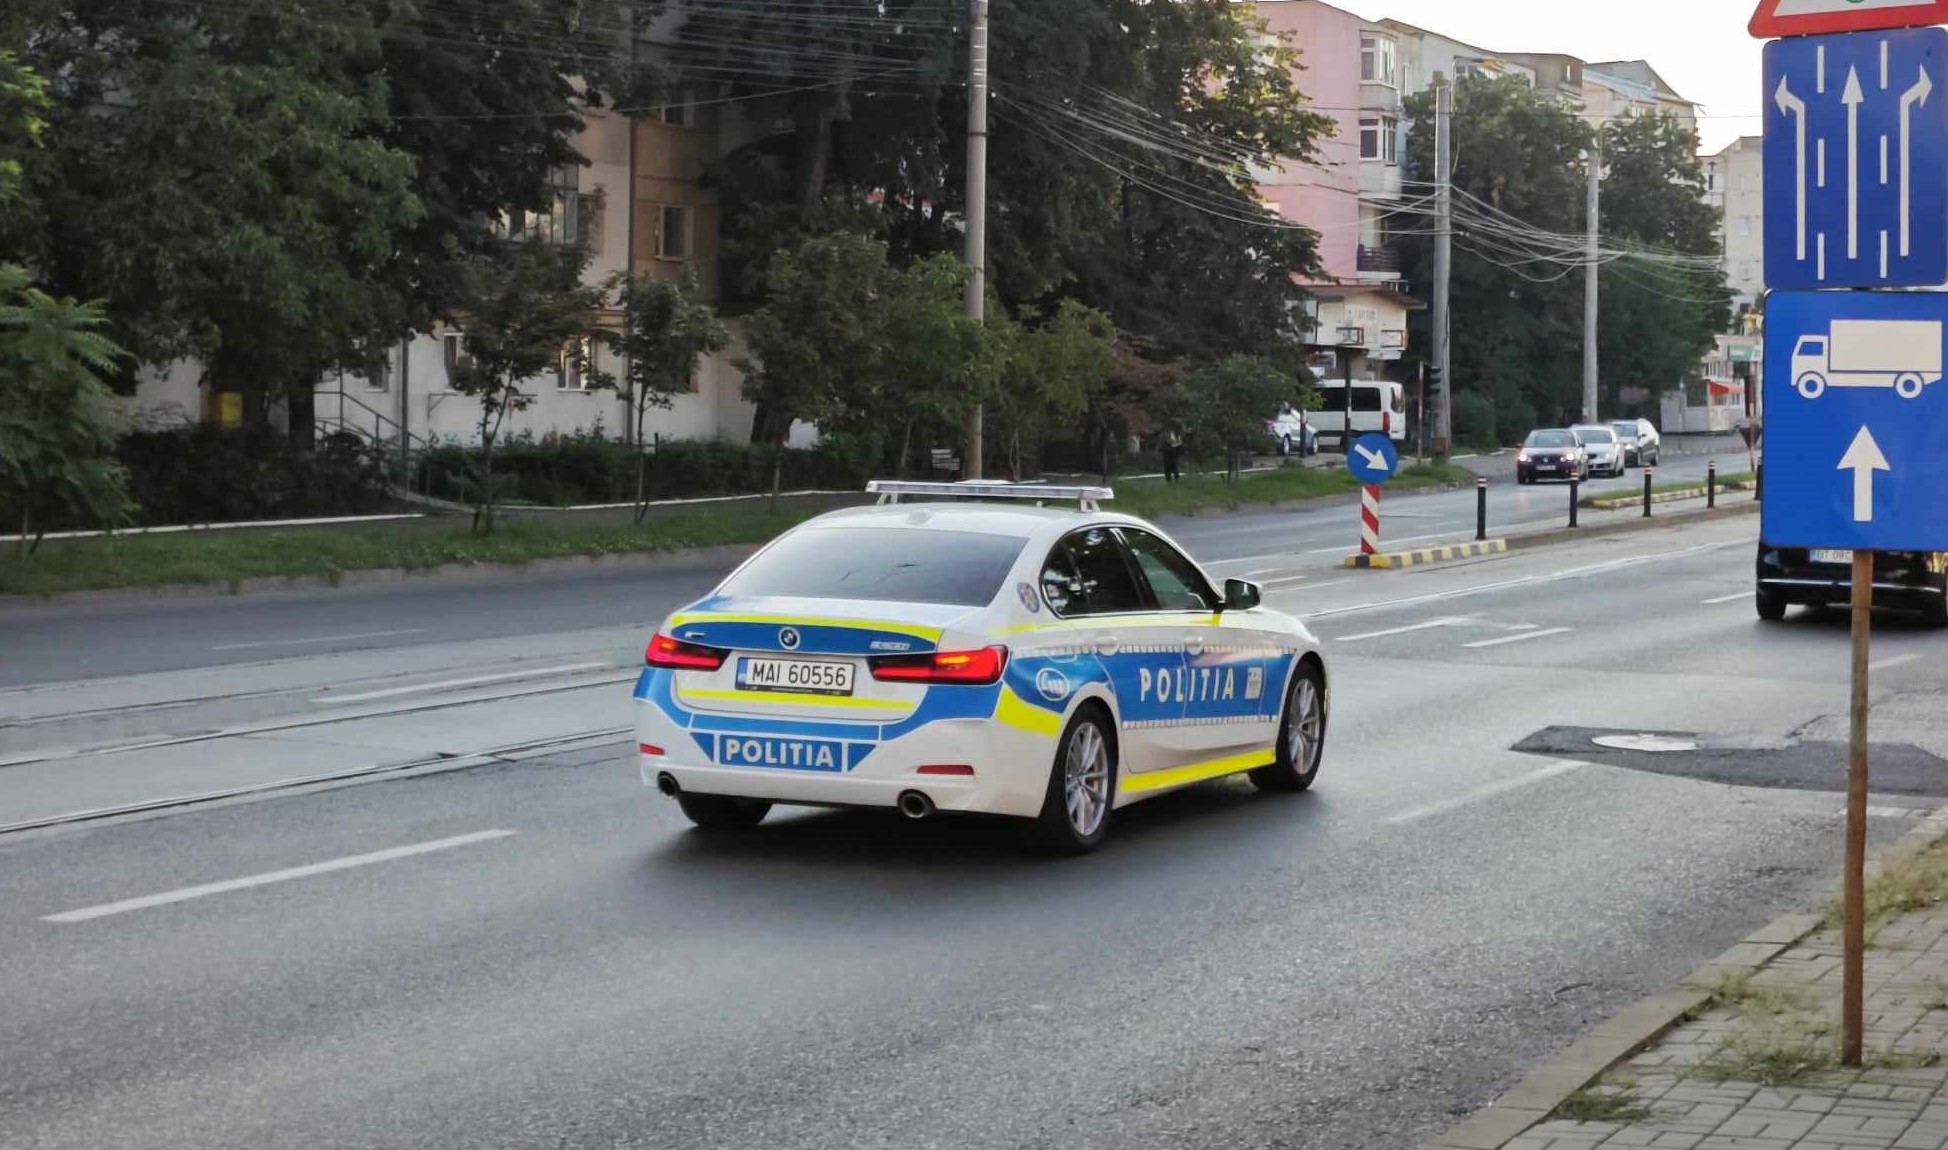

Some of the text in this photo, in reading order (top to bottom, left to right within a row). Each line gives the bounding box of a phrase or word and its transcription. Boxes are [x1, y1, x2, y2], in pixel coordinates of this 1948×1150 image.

[752, 662, 846, 686] MAI 60556
[1139, 667, 1233, 703] POLITIA
[725, 738, 834, 767] POLITIA
